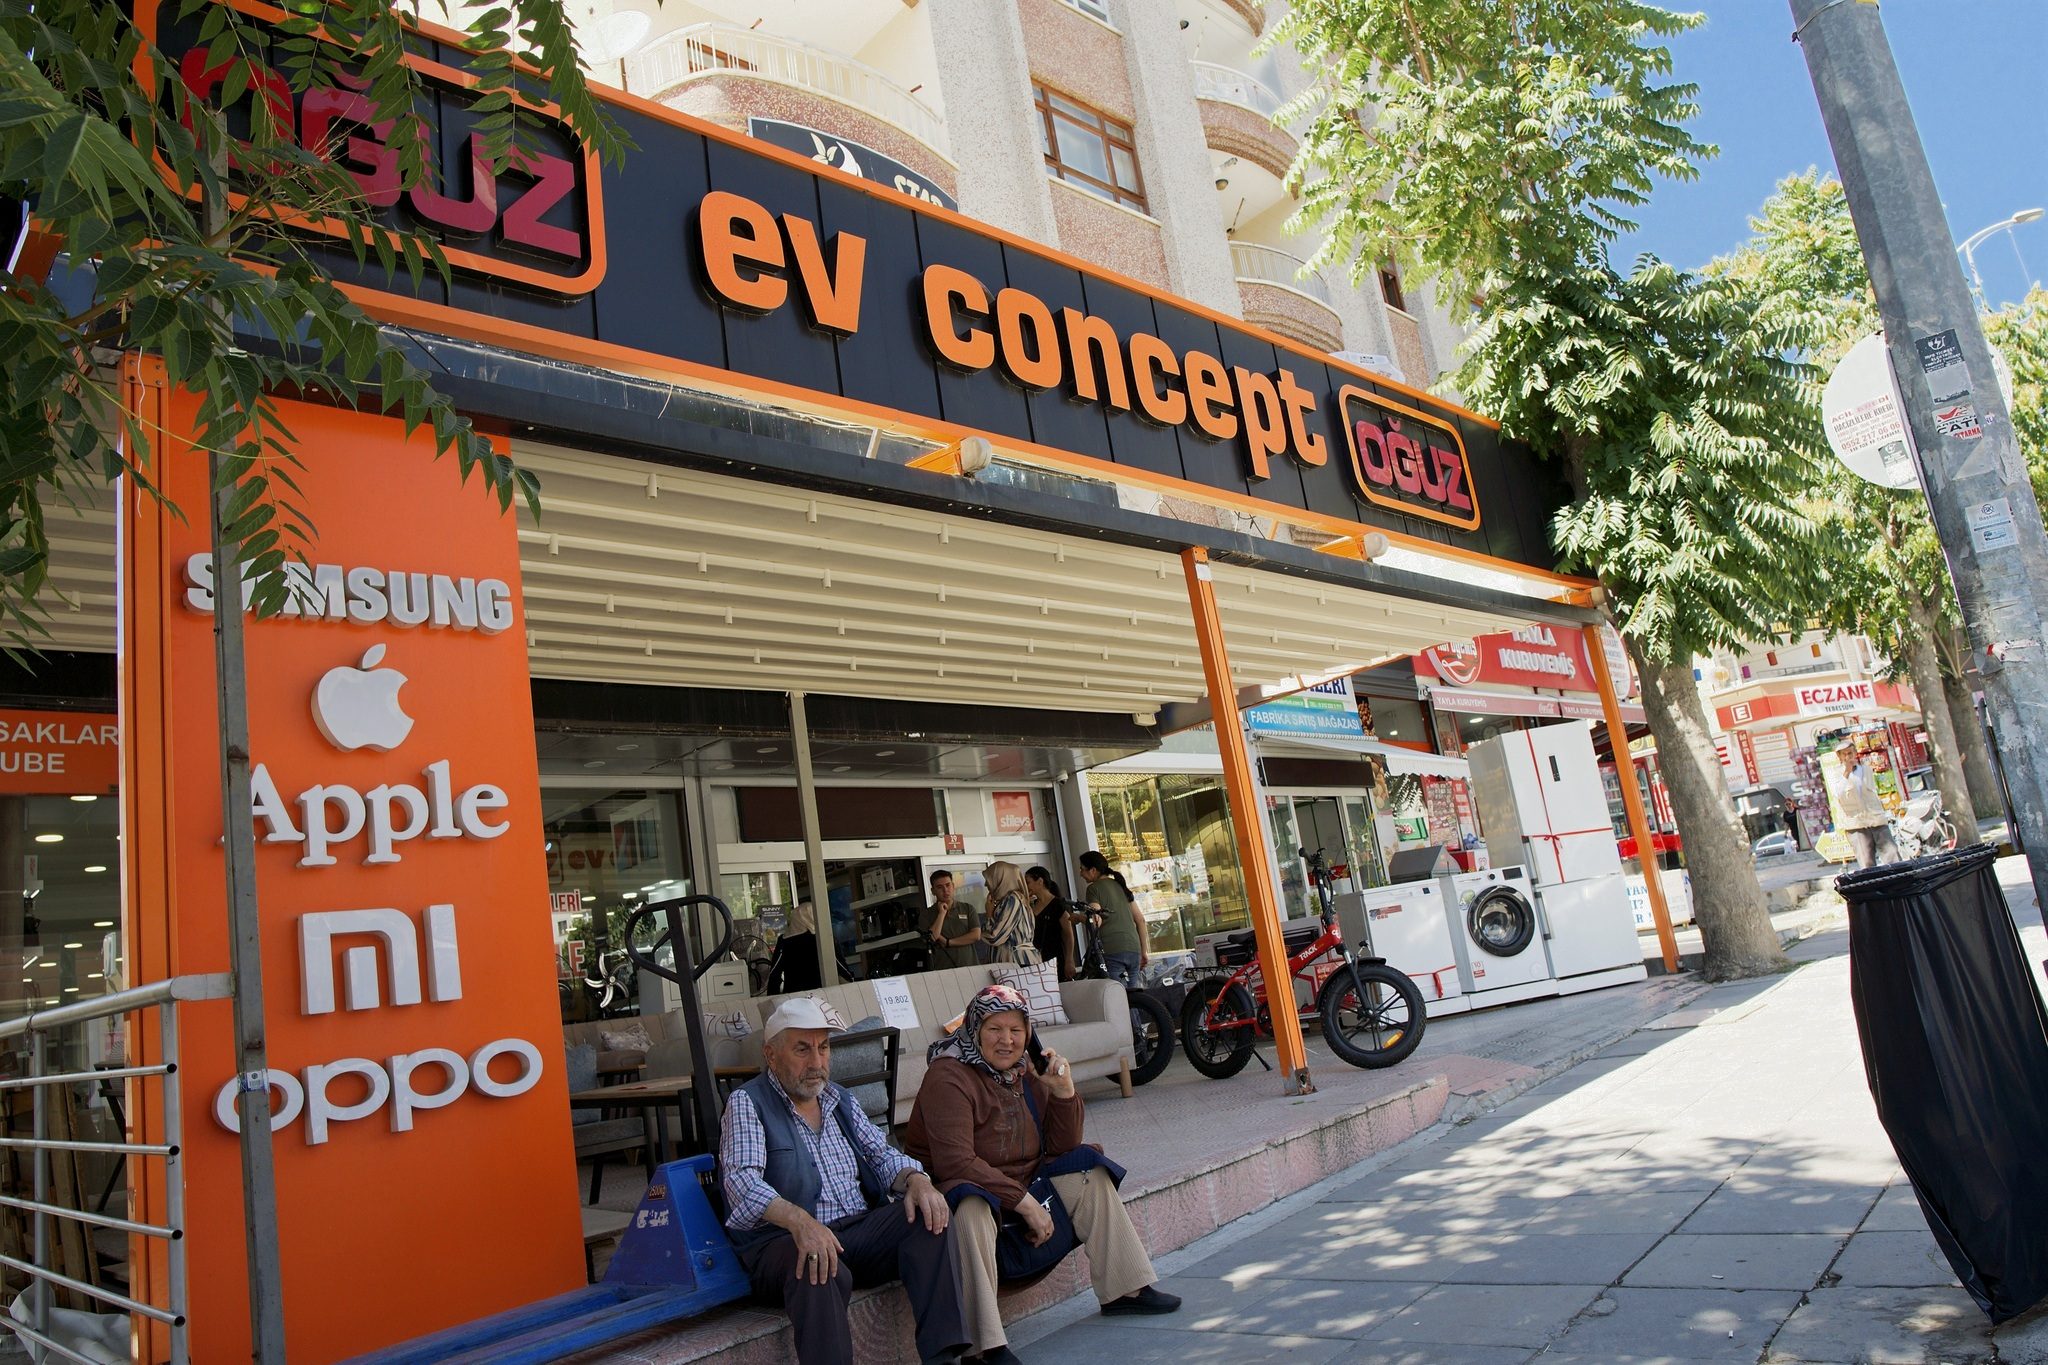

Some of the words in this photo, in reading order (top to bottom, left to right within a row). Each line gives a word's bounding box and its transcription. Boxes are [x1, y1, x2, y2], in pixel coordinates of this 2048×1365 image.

[700, 191, 867, 333] ev
[923, 264, 1328, 481] concept
[1356, 416, 1473, 511] OĞUZ
[1499, 648, 1576, 679] KURUYEMİŞ
[1801, 684, 1871, 706] ECZANE
[1250, 710, 1292, 726] FABRİKA
[1292, 714, 1317, 730] SATIŞ
[1317, 715, 1361, 731] MAĞAZASI
[220, 759, 511, 866] Apple
[1299, 943, 1318, 961] TRACK
